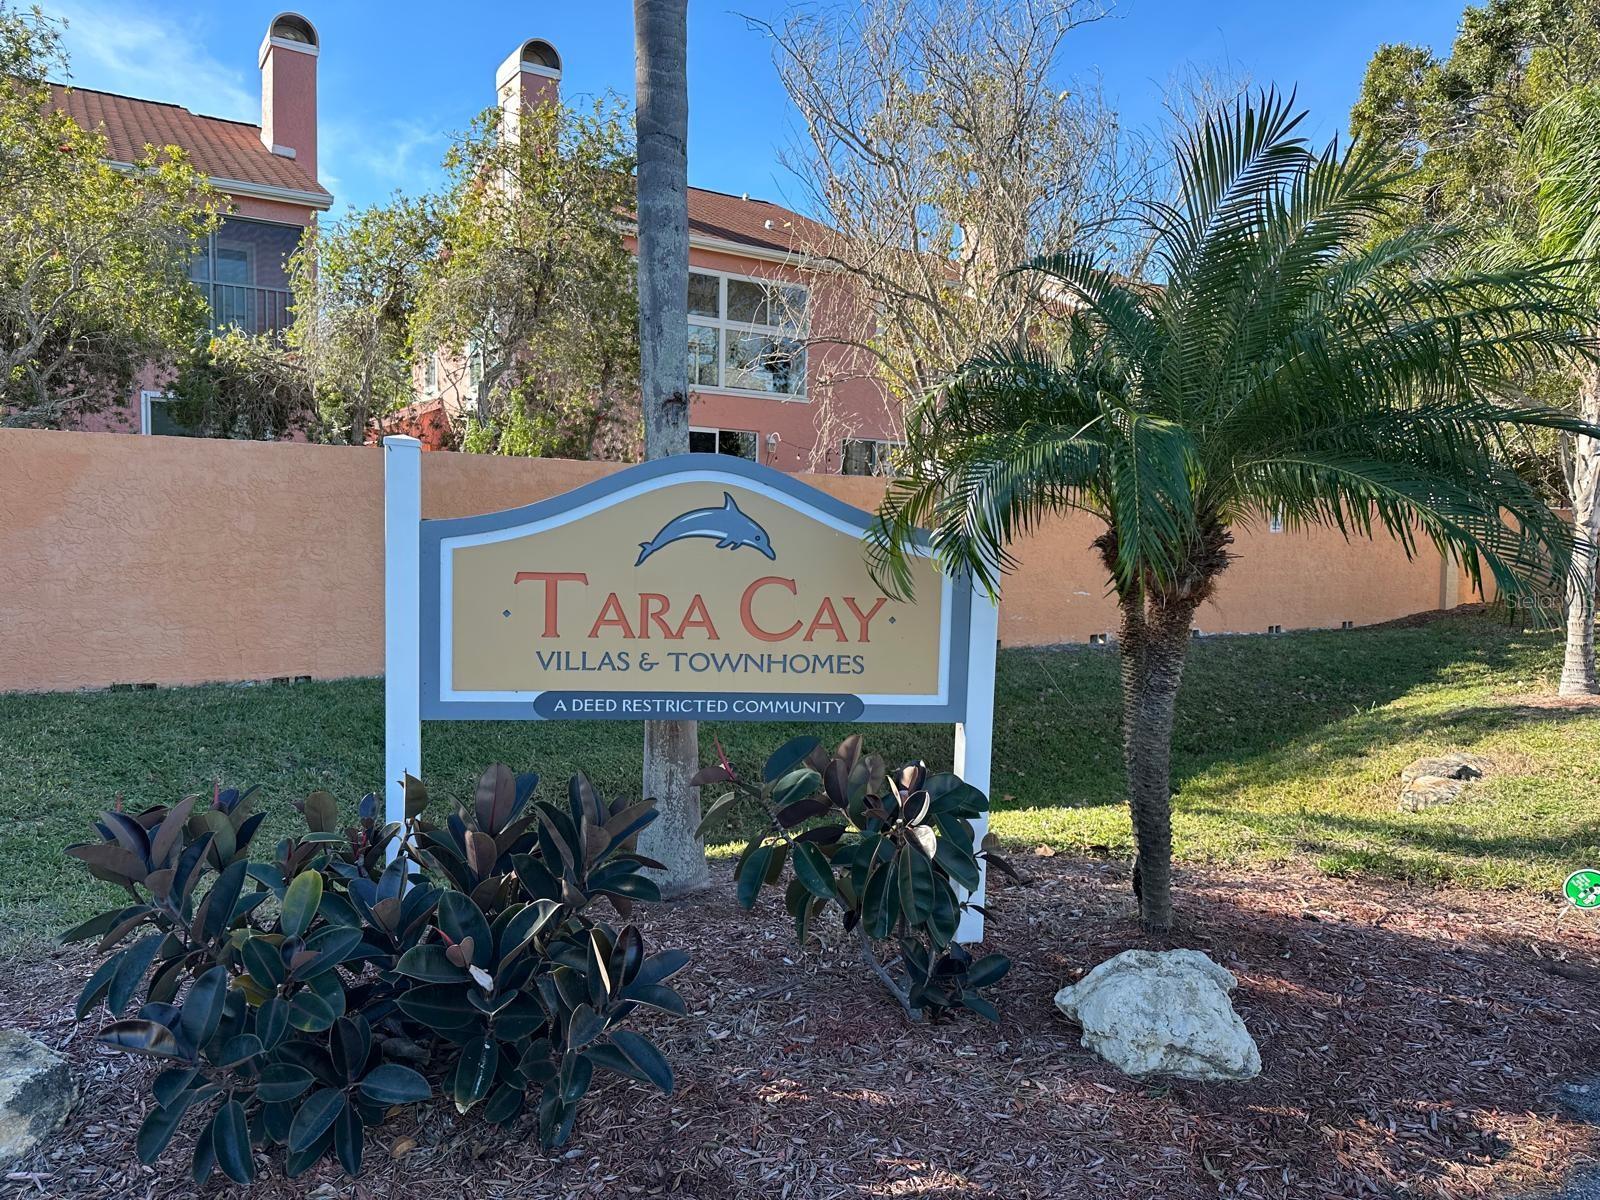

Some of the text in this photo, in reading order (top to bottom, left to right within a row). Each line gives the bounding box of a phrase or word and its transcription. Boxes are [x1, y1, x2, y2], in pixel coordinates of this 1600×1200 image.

[514, 571, 887, 643] TARA CAY
[535, 650, 865, 676] VILLAS & TOWNHOMES
[553, 699, 846, 715] A DEED RESTRICTED COMMUNITY
